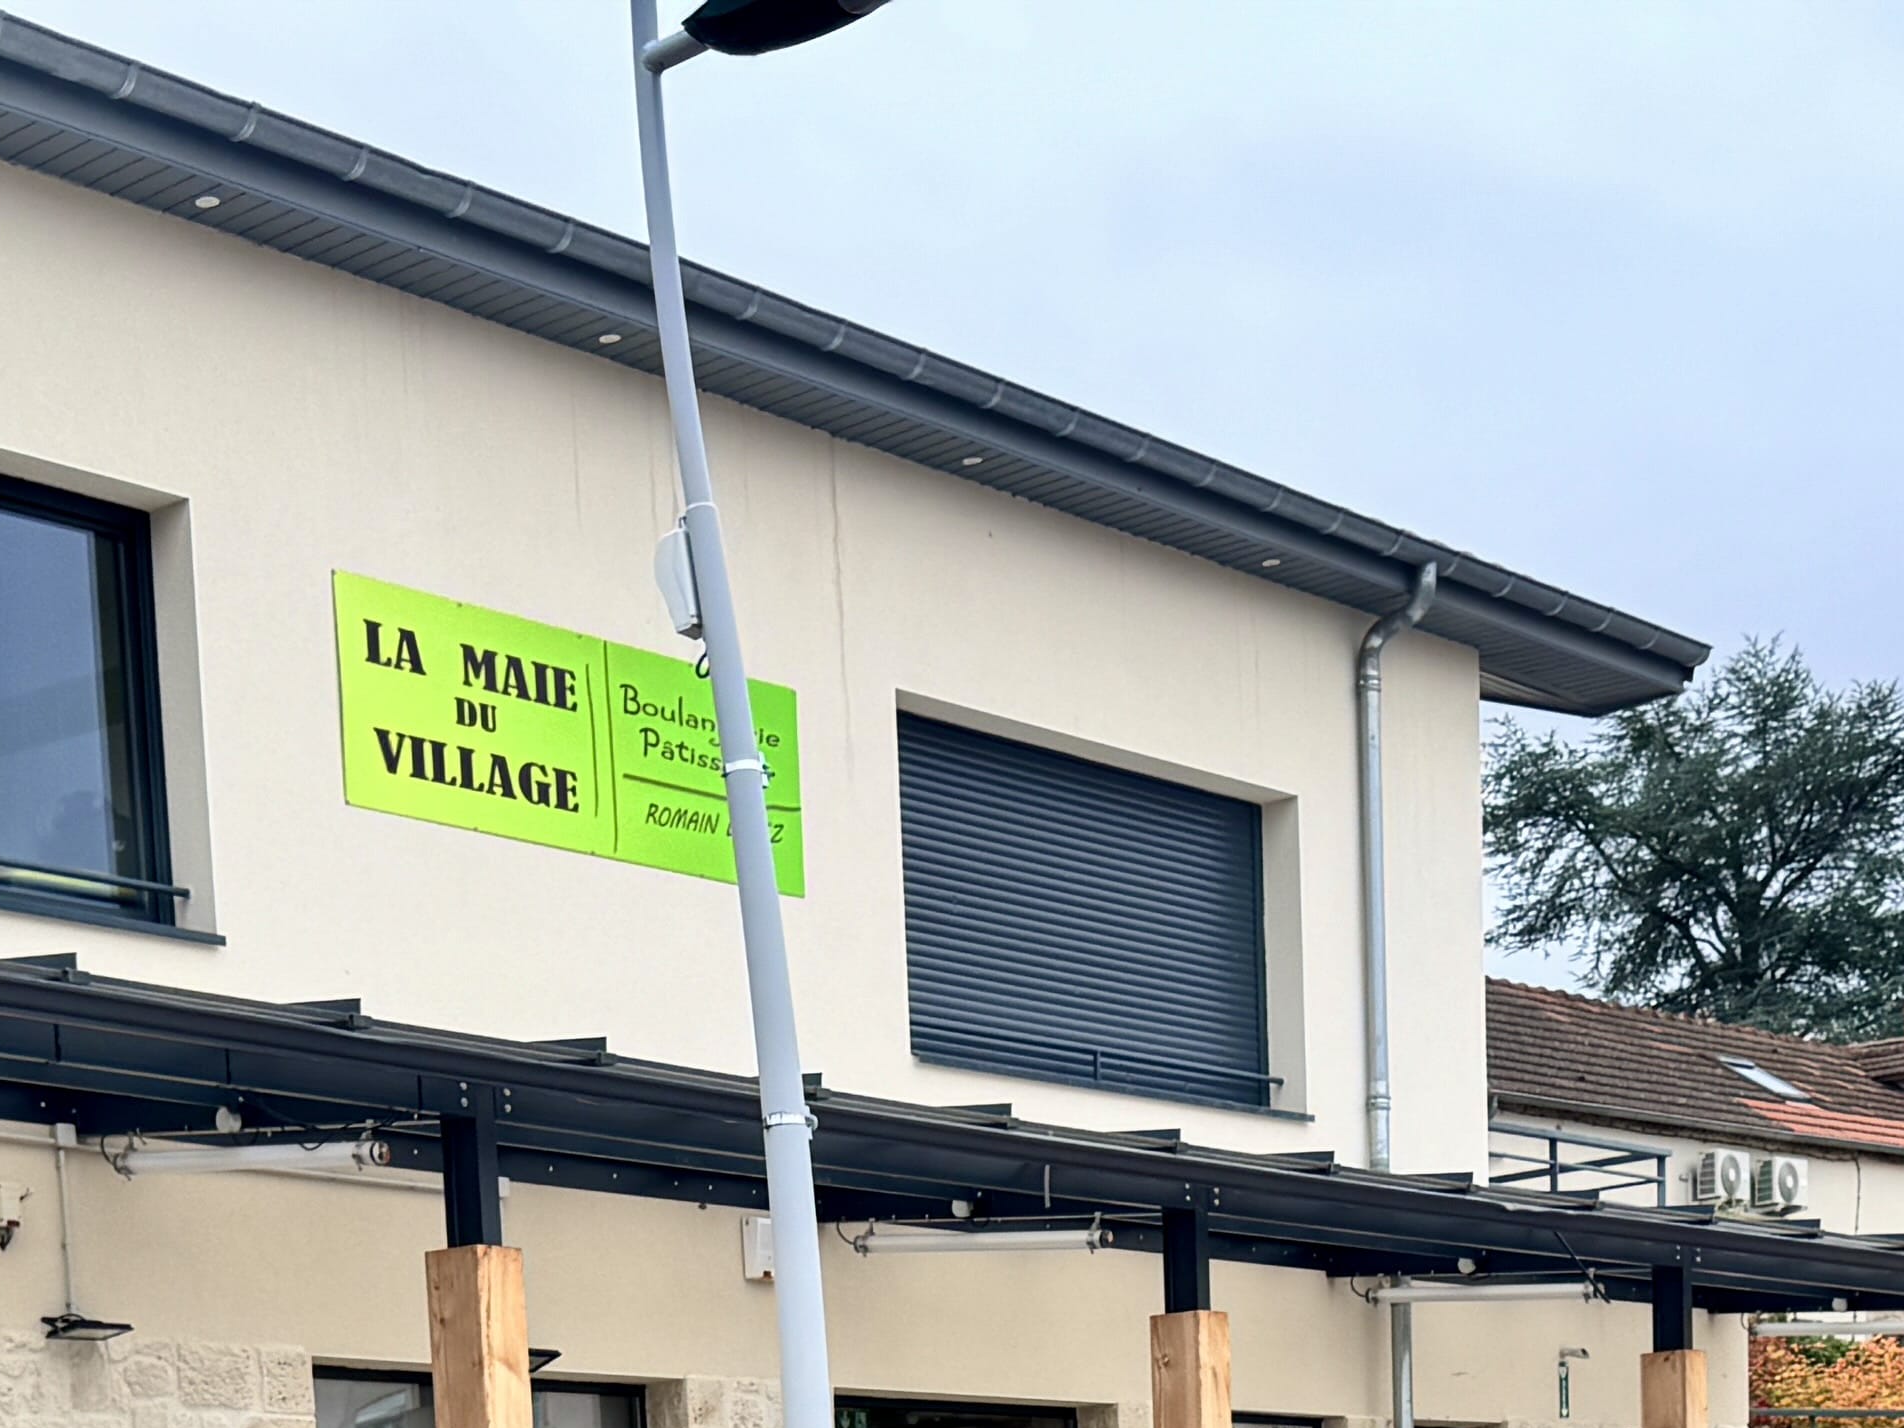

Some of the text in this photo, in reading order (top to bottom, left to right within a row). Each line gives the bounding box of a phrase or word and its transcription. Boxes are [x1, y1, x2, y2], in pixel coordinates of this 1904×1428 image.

[362, 618, 578, 712] LA MAIE
[455, 697, 498, 733] DU
[619, 684, 781, 748] Boulanie
[372, 727, 580, 813] VILLAGE
[646, 803, 721, 835] ROMAIN
